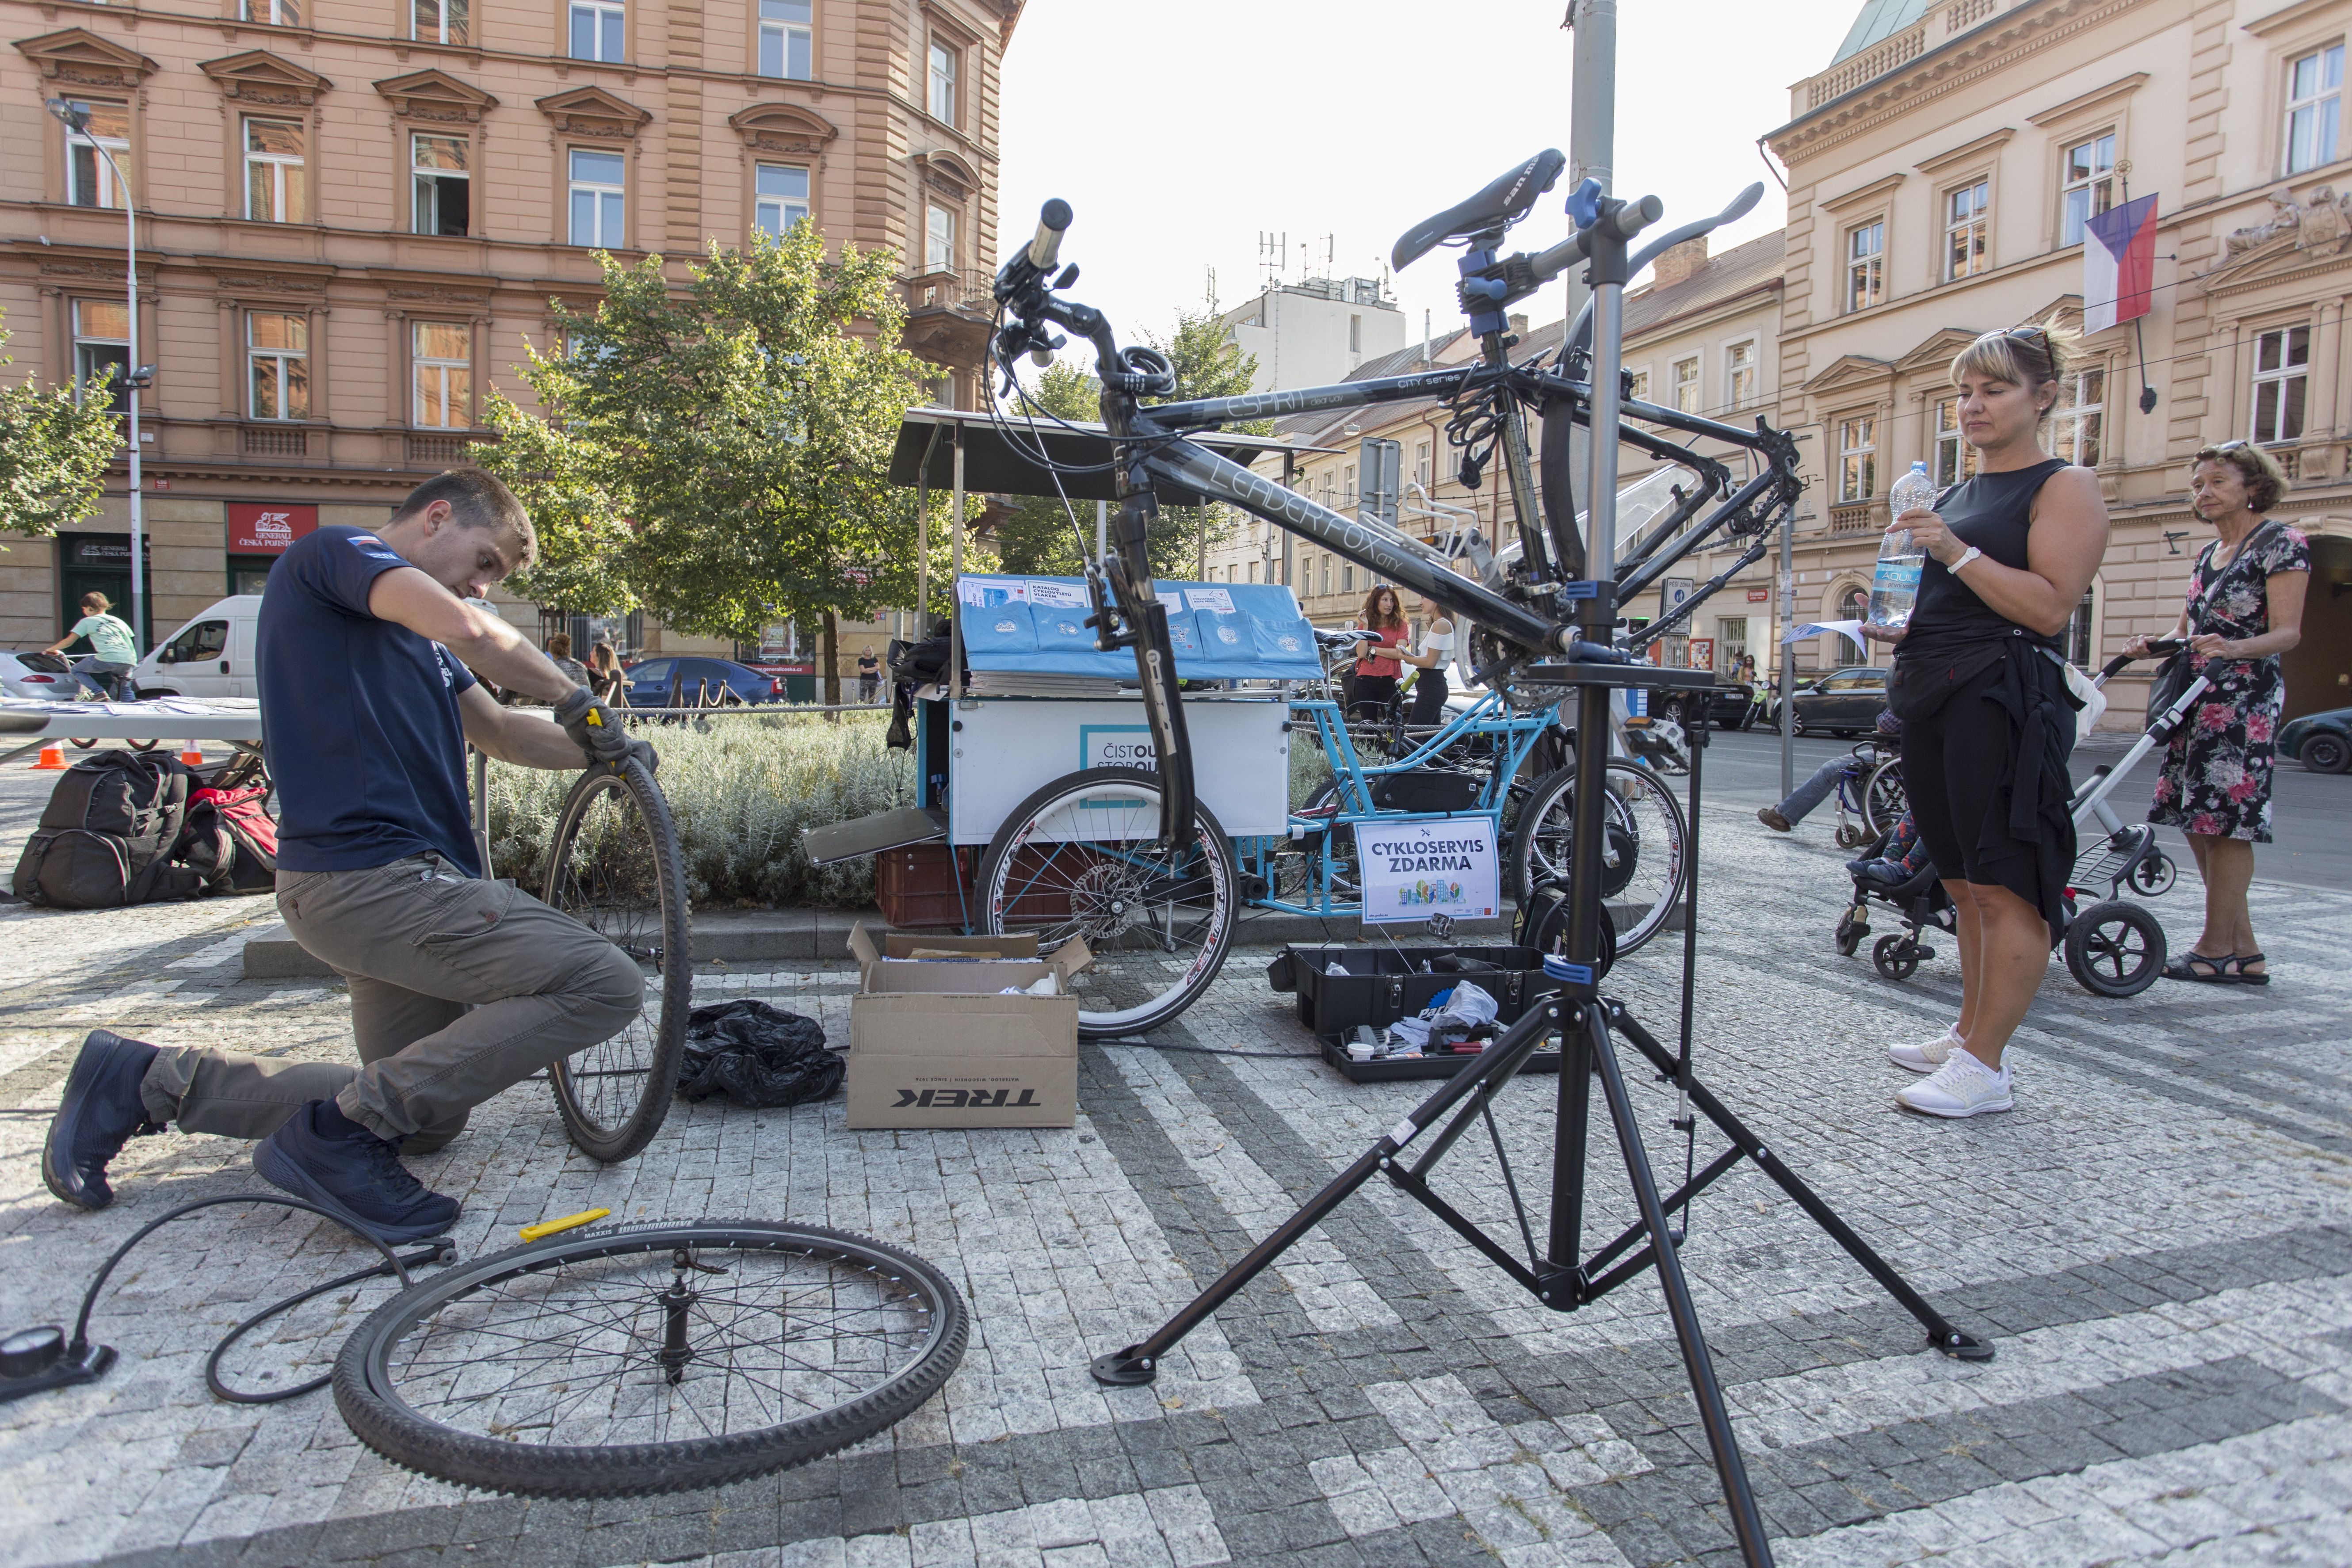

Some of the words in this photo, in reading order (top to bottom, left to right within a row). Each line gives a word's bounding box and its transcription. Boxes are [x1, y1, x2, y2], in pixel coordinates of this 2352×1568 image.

[1503, 177, 1526, 206] san
[1329, 394, 1343, 405] way
[1397, 378, 1421, 389] CITY
[1425, 373, 1461, 385] series
[1210, 459, 1323, 531] LEADER
[1324, 517, 1382, 559] FOX
[1882, 572, 1919, 582] AQUILA
[1103, 742, 1157, 758] ČISTOU
[1372, 839, 1484, 855] CYKLOSERVIS
[1389, 855, 1473, 873] ZDARMA
[1211, 859, 1224, 900] JUMBO
[1208, 900, 1225, 952] EXTREME
[889, 1089, 1041, 1108] TREK
[584, 1229, 612, 1239] MAXXIS
[617, 1220, 697, 1235] WORMDRIVE
